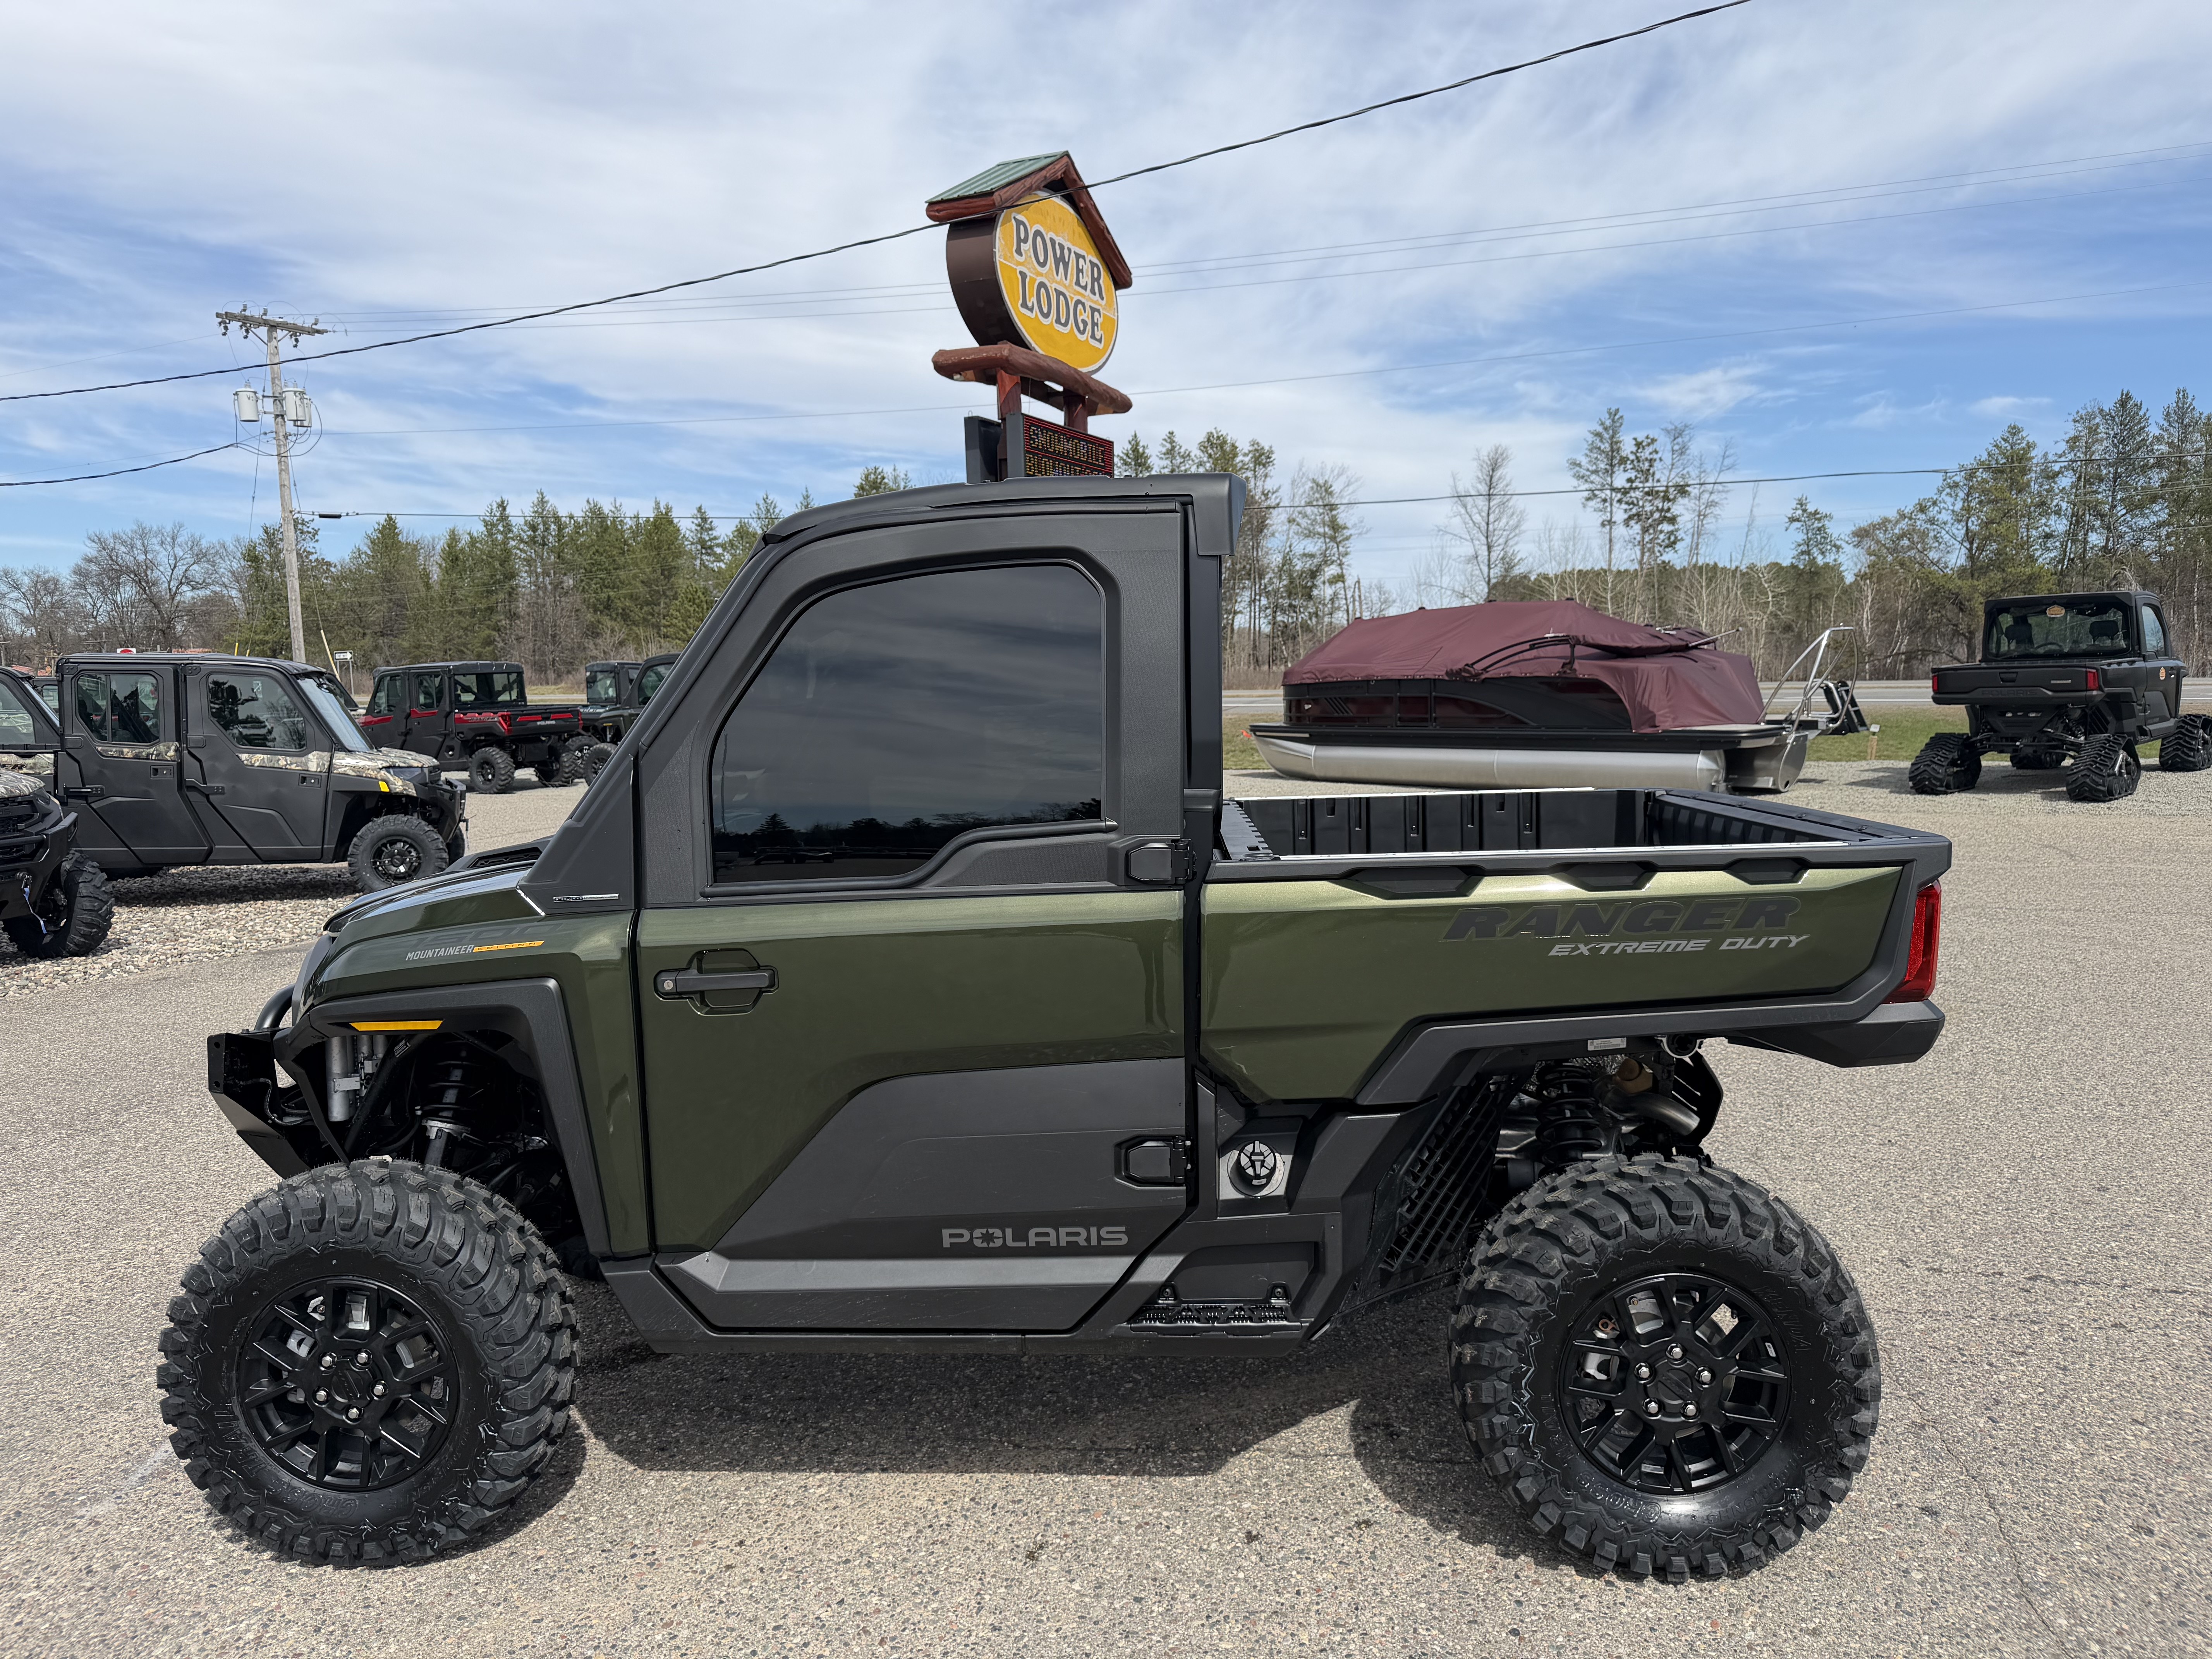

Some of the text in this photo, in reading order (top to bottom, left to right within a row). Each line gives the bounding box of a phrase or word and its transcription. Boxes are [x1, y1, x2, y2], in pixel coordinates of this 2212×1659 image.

[1012, 213, 1106, 304] POWER
[1017, 268, 1104, 347] LODGE
[1029, 426, 1105, 465] SNOWMOBILE
[1438, 896, 1801, 941] RANGER
[405, 942, 536, 961] MOUNTAINEER EDITION
[1548, 934, 1810, 956] EXTREME DUTY
[941, 1226, 1128, 1248] POLARIS
[213, 1403, 359, 1520] CROSS TRAIL
[1540, 1393, 1661, 1523] CROSS TRAIL
